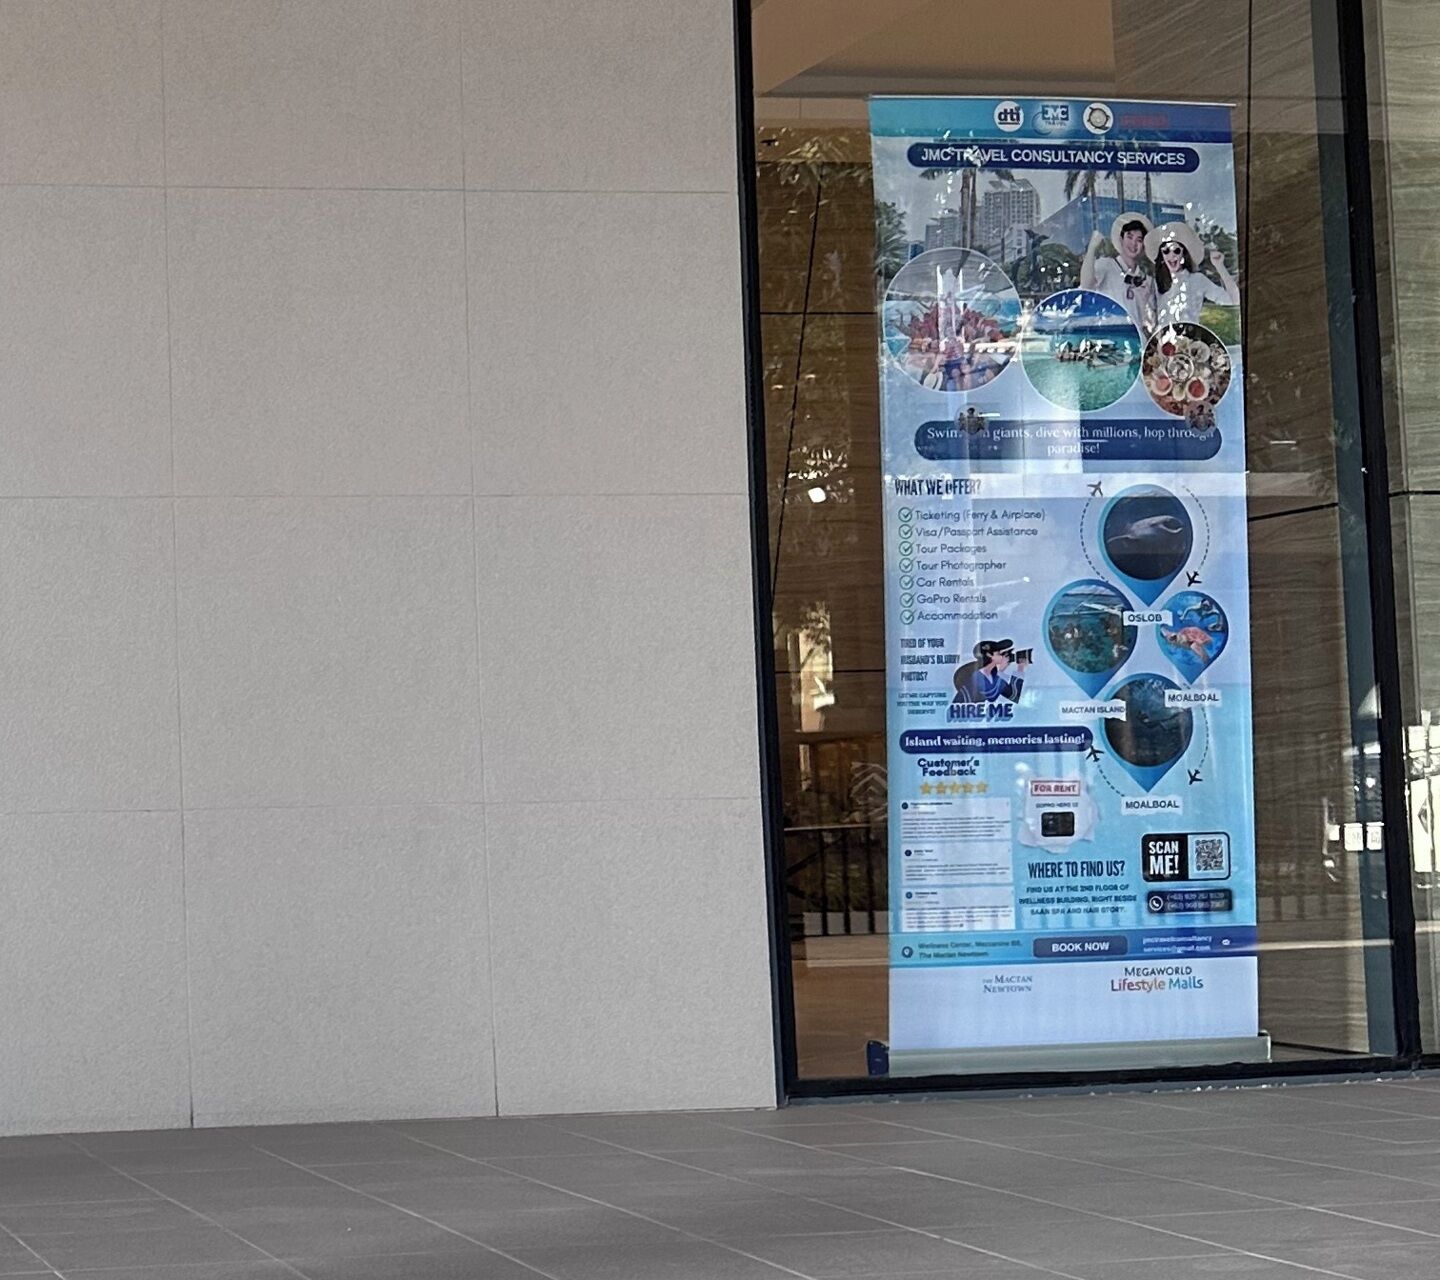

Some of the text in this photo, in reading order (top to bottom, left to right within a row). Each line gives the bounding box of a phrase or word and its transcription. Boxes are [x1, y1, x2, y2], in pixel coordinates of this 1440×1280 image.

[997, 105, 1021, 122] dti
[921, 148, 1186, 166] JMC TRAVEL CONSULTANCY SERVICES
[1035, 426, 1060, 438] dive
[1062, 426, 1089, 438] with
[1092, 426, 1142, 439] millions,
[1144, 426, 1166, 441] hop
[1047, 443, 1101, 457] paradise!
[894, 478, 982, 496] WHAT WE OFFER?
[915, 508, 1046, 522] Ticketing (Ferry & Airplane)
[916, 526, 1038, 538] Visa/Passport Assistance
[916, 543, 987, 555] Tour Packages
[916, 559, 1007, 573] Tour Photographer
[916, 577, 975, 588] Car Rentals
[916, 593, 987, 604] GoPro Rentals
[917, 610, 998, 621] Accommodation
[1127, 613, 1163, 623] OSLOB
[918, 638, 926, 649] OF
[1167, 693, 1220, 703] MOALBOAL
[949, 703, 1014, 720] HIRE ME
[1061, 706, 1096, 714] MACTAN
[905, 732, 1085, 747] Island waiting, memories lasting!
[917, 757, 980, 768] Customer's
[922, 767, 976, 777] Feedback
[1034, 784, 1077, 793] FOR RENT
[1125, 800, 1180, 809] MOALBOAL
[1148, 840, 1179, 854] SCAN
[1028, 861, 1064, 879] WHERE
[1065, 861, 1078, 878] TO
[1080, 860, 1104, 877] FIND
[1106, 860, 1126, 877] US?
[1149, 854, 1179, 875] ME!
[1066, 885, 1079, 893] THE
[1095, 884, 1118, 892] FLOOR
[1051, 941, 1110, 953] BOOK NOW
[1124, 966, 1193, 977] MEGAWORLD
[1111, 976, 1204, 992] Lifestyle Malls
